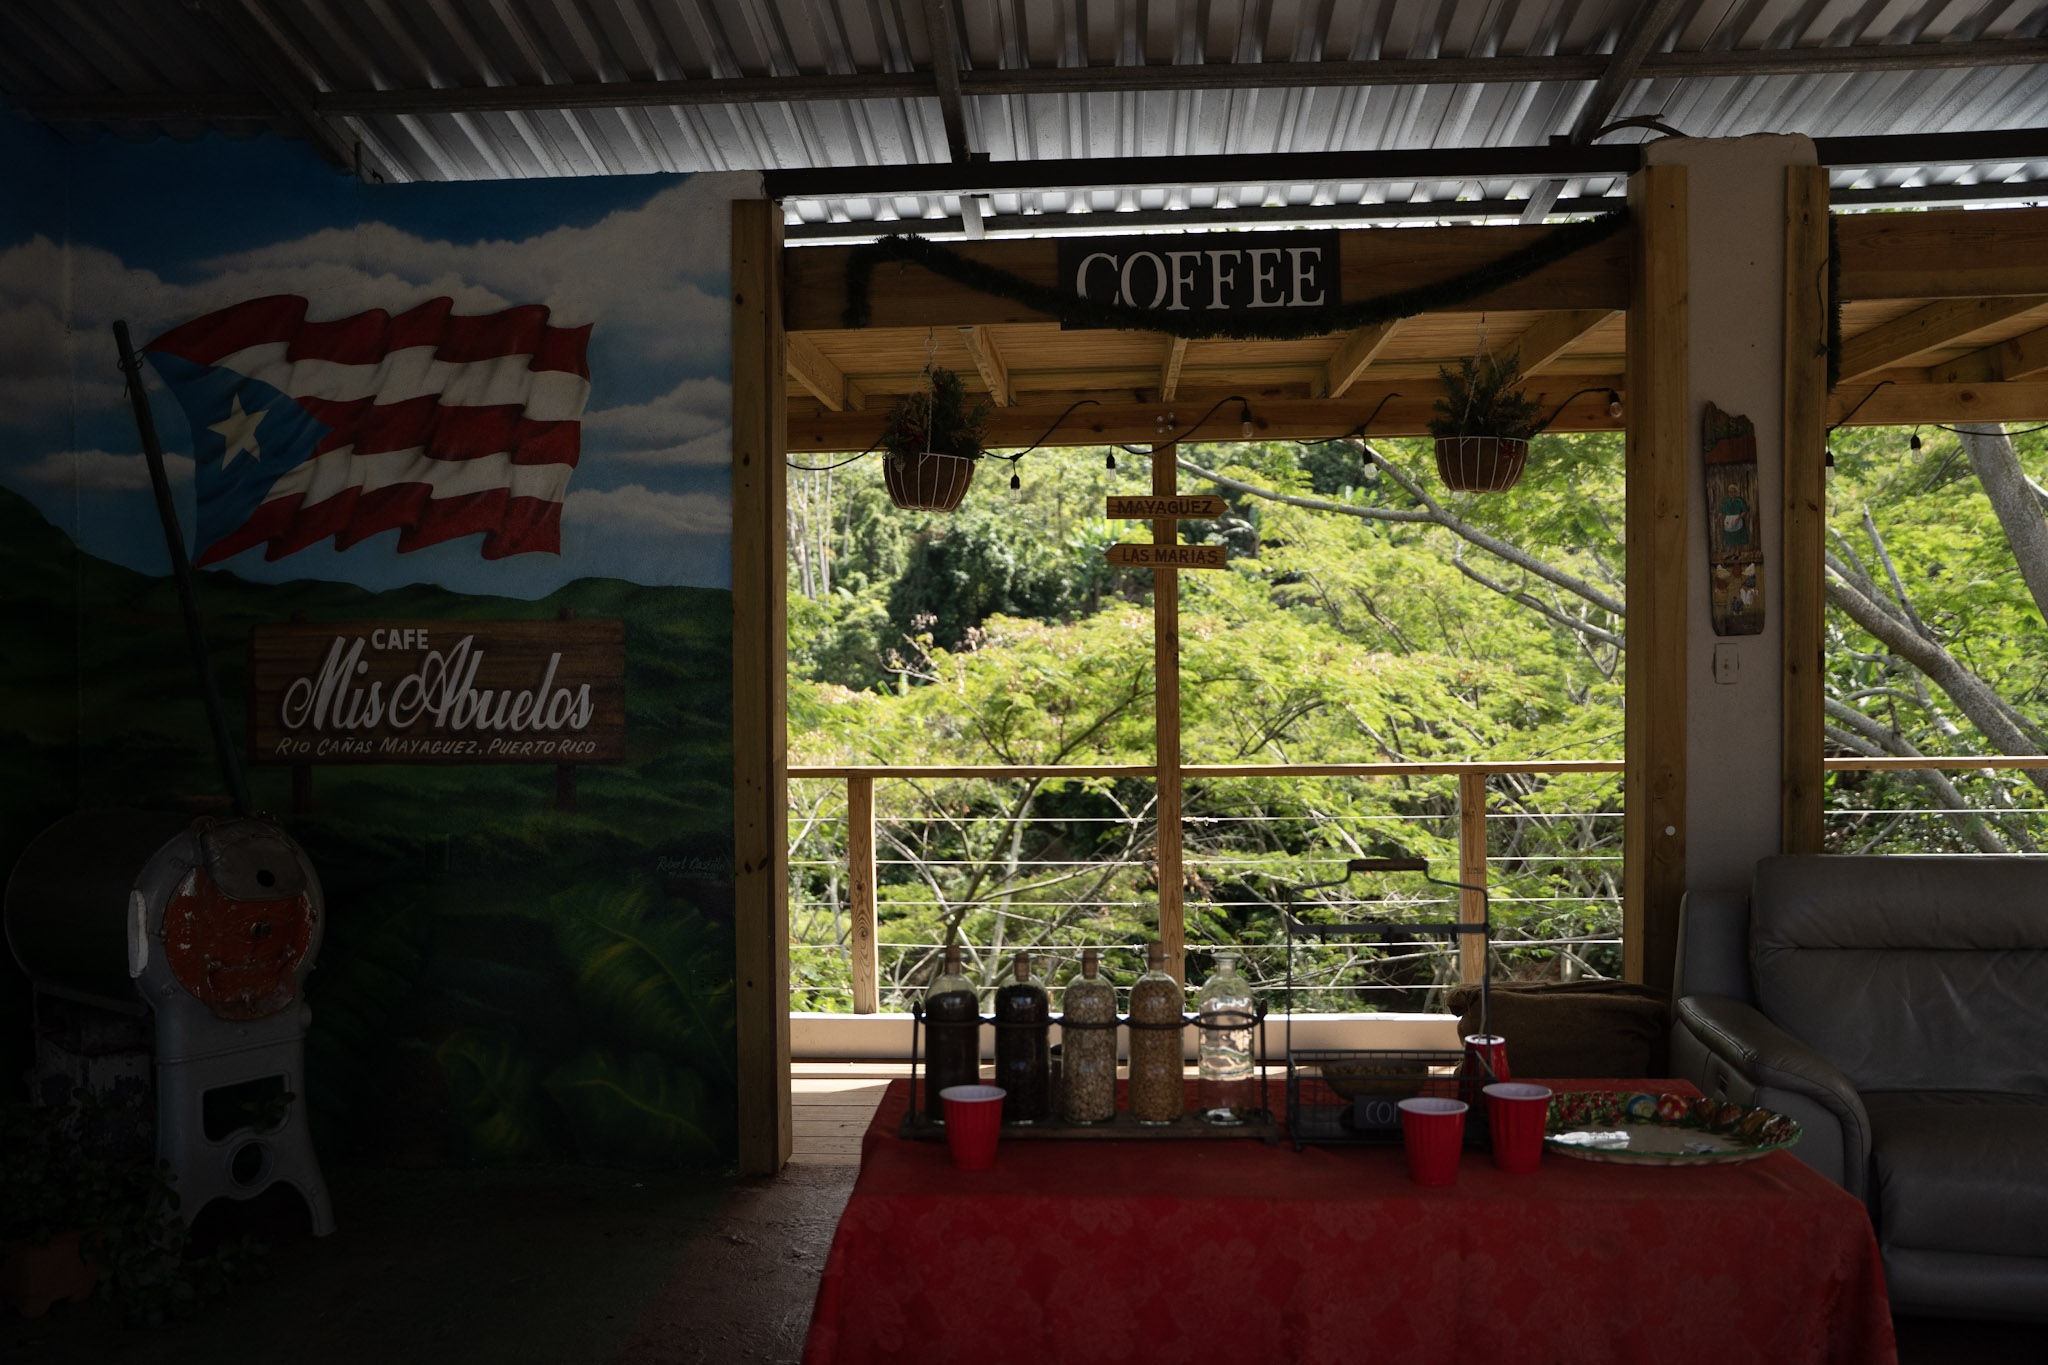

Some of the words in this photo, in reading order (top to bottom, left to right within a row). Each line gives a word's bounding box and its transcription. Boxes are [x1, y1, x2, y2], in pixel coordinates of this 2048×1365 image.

[1076, 247, 1325, 311] COFFEE
[1122, 548, 1150, 562] LAS
[1154, 549, 1218, 564] MARIAS
[371, 629, 429, 650] CAFE
[281, 635, 386, 730] Mis
[387, 634, 595, 732] Abuelos
[487, 737, 556, 756] PUERTO
[557, 738, 597, 755] RICO
